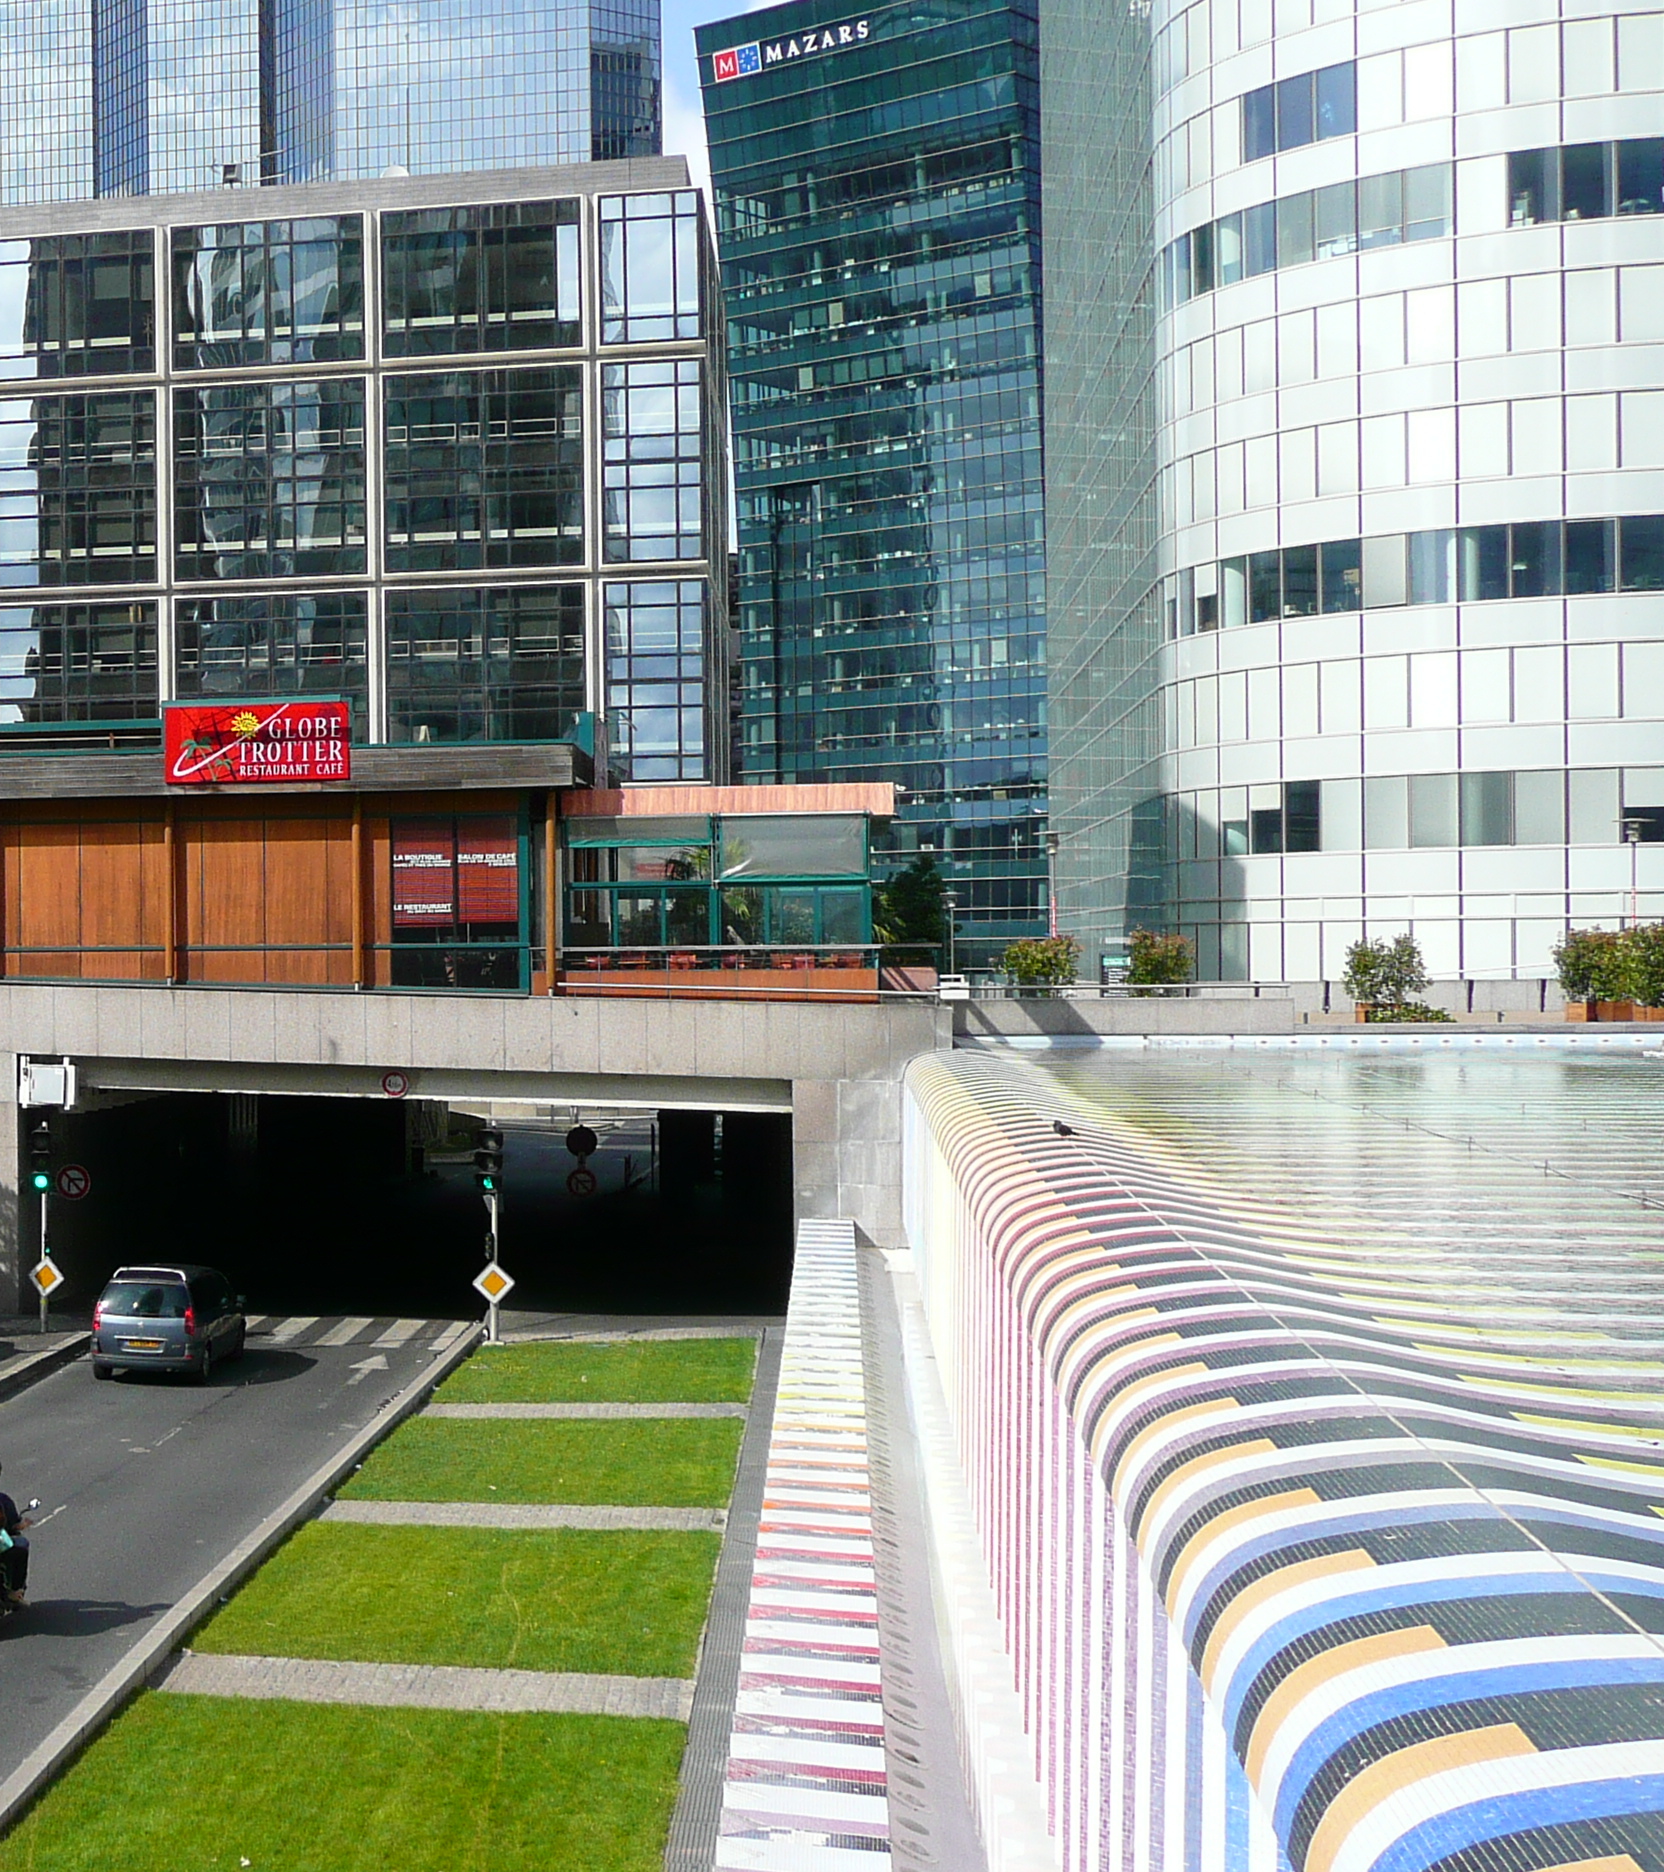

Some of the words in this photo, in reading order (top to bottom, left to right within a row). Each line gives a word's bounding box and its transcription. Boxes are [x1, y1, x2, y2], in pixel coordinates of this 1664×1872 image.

[719, 56, 735, 75] M
[765, 20, 869, 64] MAZARS
[268, 717, 342, 739] GLOBE
[236, 740, 344, 763] TROTTER
[239, 764, 310, 776] RESTAURANT
[316, 762, 344, 775] CAFÉ
